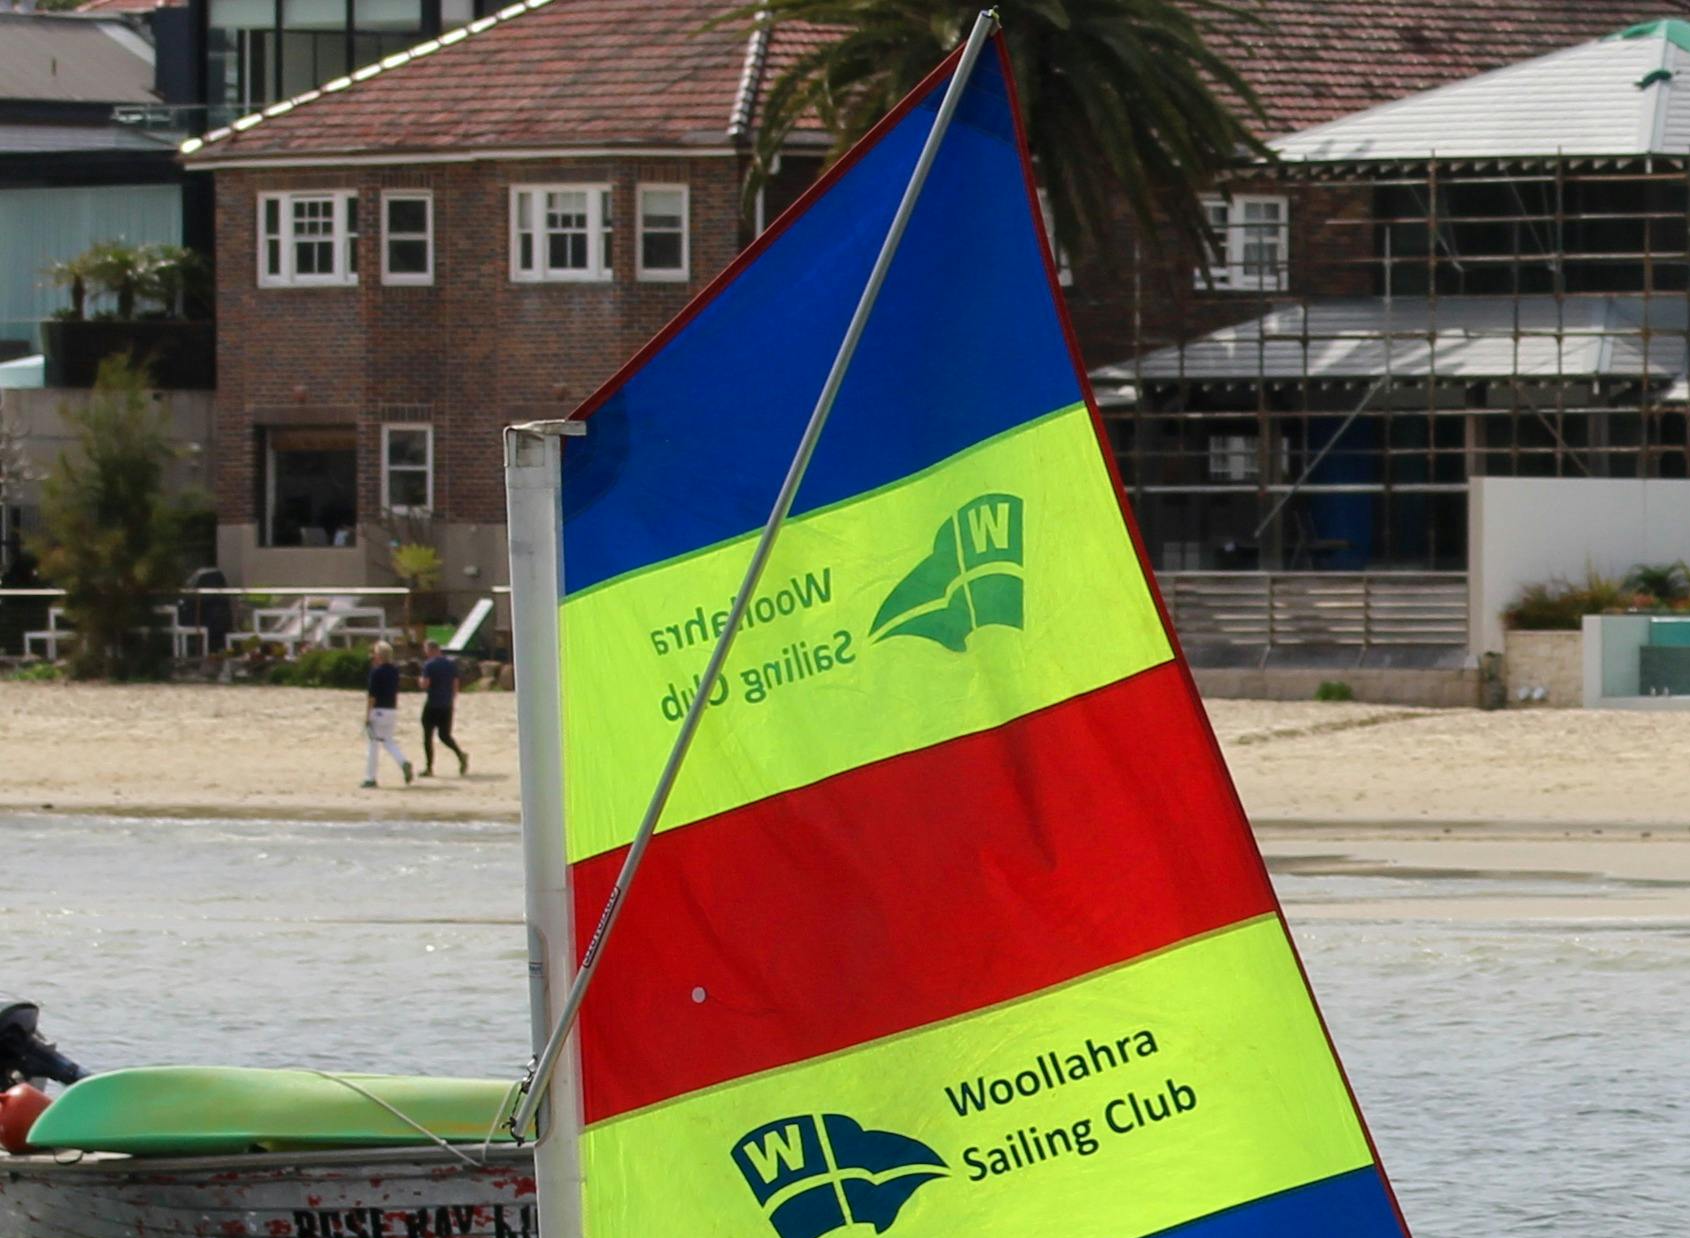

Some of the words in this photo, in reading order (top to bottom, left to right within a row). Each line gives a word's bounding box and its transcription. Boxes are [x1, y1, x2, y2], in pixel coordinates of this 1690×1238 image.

[945, 1028, 1159, 1118] Woollahra
[742, 1123, 806, 1184] W
[963, 1118, 1100, 1182] Sailing
[1104, 1078, 1197, 1135] Club
